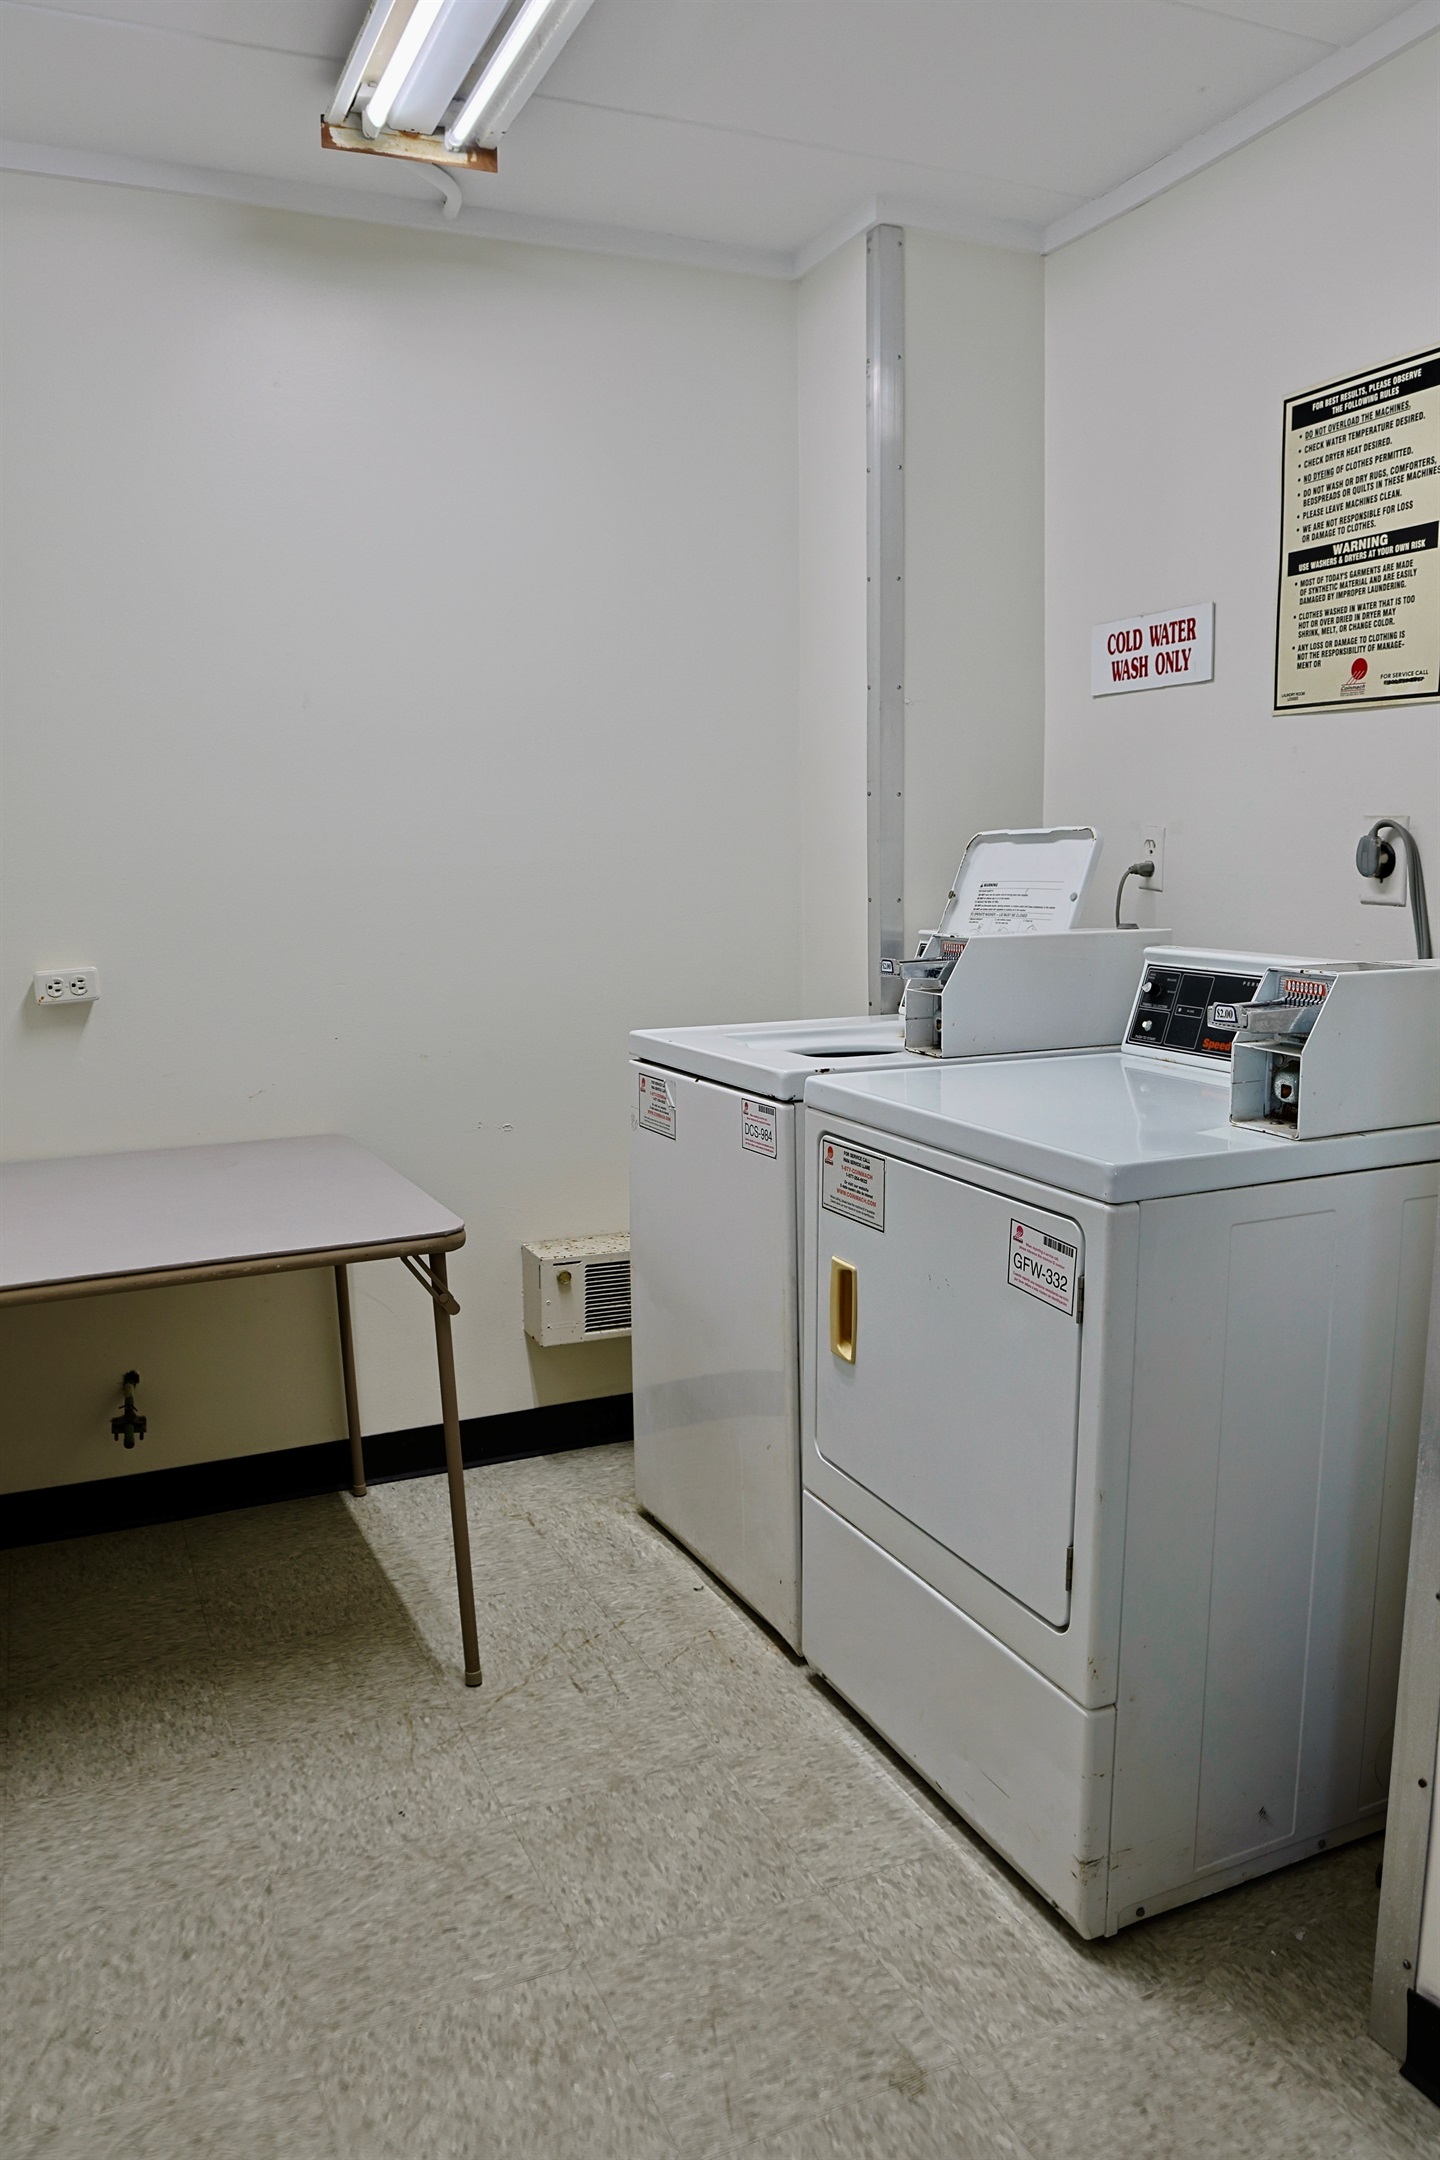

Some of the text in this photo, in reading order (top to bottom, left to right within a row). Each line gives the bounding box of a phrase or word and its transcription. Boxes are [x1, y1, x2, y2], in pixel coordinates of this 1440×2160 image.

[1312, 368, 1422, 411] FOR BEST RESULTS, PLEASE OBSERVE
[1332, 386, 1399, 414] THE FOLLOWING RULES
[1305, 430, 1313, 439] DO
[1315, 426, 1326, 436] NOT
[1328, 416, 1359, 432] OVERLOAD
[1361, 412, 1373, 421] THE
[1305, 412, 1425, 453] CHECK WATER TEMPERATURE DESIRED.
[1304, 437, 1392, 468] CHECK DRYER HEAT DESIRED.
[1304, 447, 1413, 483] NO DYEING OF CLOTHES PERMITTED.
[1303, 489, 1311, 497] DO
[1313, 485, 1324, 494] NOT
[1326, 480, 1343, 492] WASH
[1345, 478, 1353, 486] OR
[1356, 473, 1368, 484] DRY
[1390, 456, 1437, 475] COMFORTERS,
[1303, 490, 1341, 507] BEDSPREADS
[1342, 488, 1351, 497] OR
[1352, 482, 1374, 495] QUILTS
[1376, 480, 1382, 489] IN
[1385, 474, 1404, 486] THESE
[1303, 489, 1402, 520] PLEASE LEAVE MACHINES CLEAN.
[1303, 500, 1413, 533] WE ARE NOT RESPONSIBLE FOR LOSS
[1302, 520, 1376, 543] OR DAMAGE TO CLOTHES.
[1333, 534, 1388, 555] WARNING
[1299, 563, 1309, 572] USE
[1311, 557, 1337, 569] WASHERS
[1344, 551, 1367, 563] DRYERS
[1368, 549, 1376, 558] AT
[1378, 546, 1394, 556] YOUR
[1395, 542, 1410, 552] OWN
[1411, 539, 1426, 550] RISK
[1300, 559, 1414, 587] MOST OF TODAY'S GARMENTS ARE MADE
[1300, 568, 1418, 596] OF SYNTHETIC MATERIAL AND ARE EASILY
[1300, 580, 1406, 605] DAMAGED BY IMPROPER LAUNDERING.
[1298, 621, 1309, 629] HOT
[1320, 617, 1334, 626] OVER
[1336, 614, 1353, 624] DRIED
[1362, 610, 1381, 620] DRYER
[1383, 608, 1396, 616] MAY
[1299, 610, 1323, 620] CLOTHES
[1324, 606, 1348, 616] WASHED
[1357, 601, 1377, 611] WATER
[1379, 598, 1394, 608] THAT
[1396, 597, 1401, 605] IS
[1403, 595, 1416, 604] TOO
[1107, 617, 1196, 655] COLD WATER
[1298, 629, 1320, 638] SHRINK,
[1321, 626, 1338, 635] MELT,
[1349, 621, 1372, 631] CHANGE
[1373, 618, 1395, 628] COLOR.
[1310, 641, 1323, 650] LOSS
[1334, 637, 1358, 647] DAMAGE
[1369, 631, 1397, 642] CLOTHING
[1399, 630, 1405, 638] IS
[1309, 651, 1320, 659] THE
[1321, 645, 1366, 658] RESPONSIBILITY
[1368, 644, 1375, 652] OF
[1377, 640, 1405, 651] MANAGE-
[1111, 648, 1192, 682] WASH ONLY
[1297, 661, 1312, 670] MENT
[1217, 1008, 1233, 1018] $2.00
[1203, 1038, 1231, 1051] Speed
[745, 1123, 772, 1142] DCS-984
[1013, 1252, 1068, 1293] GFW-332
